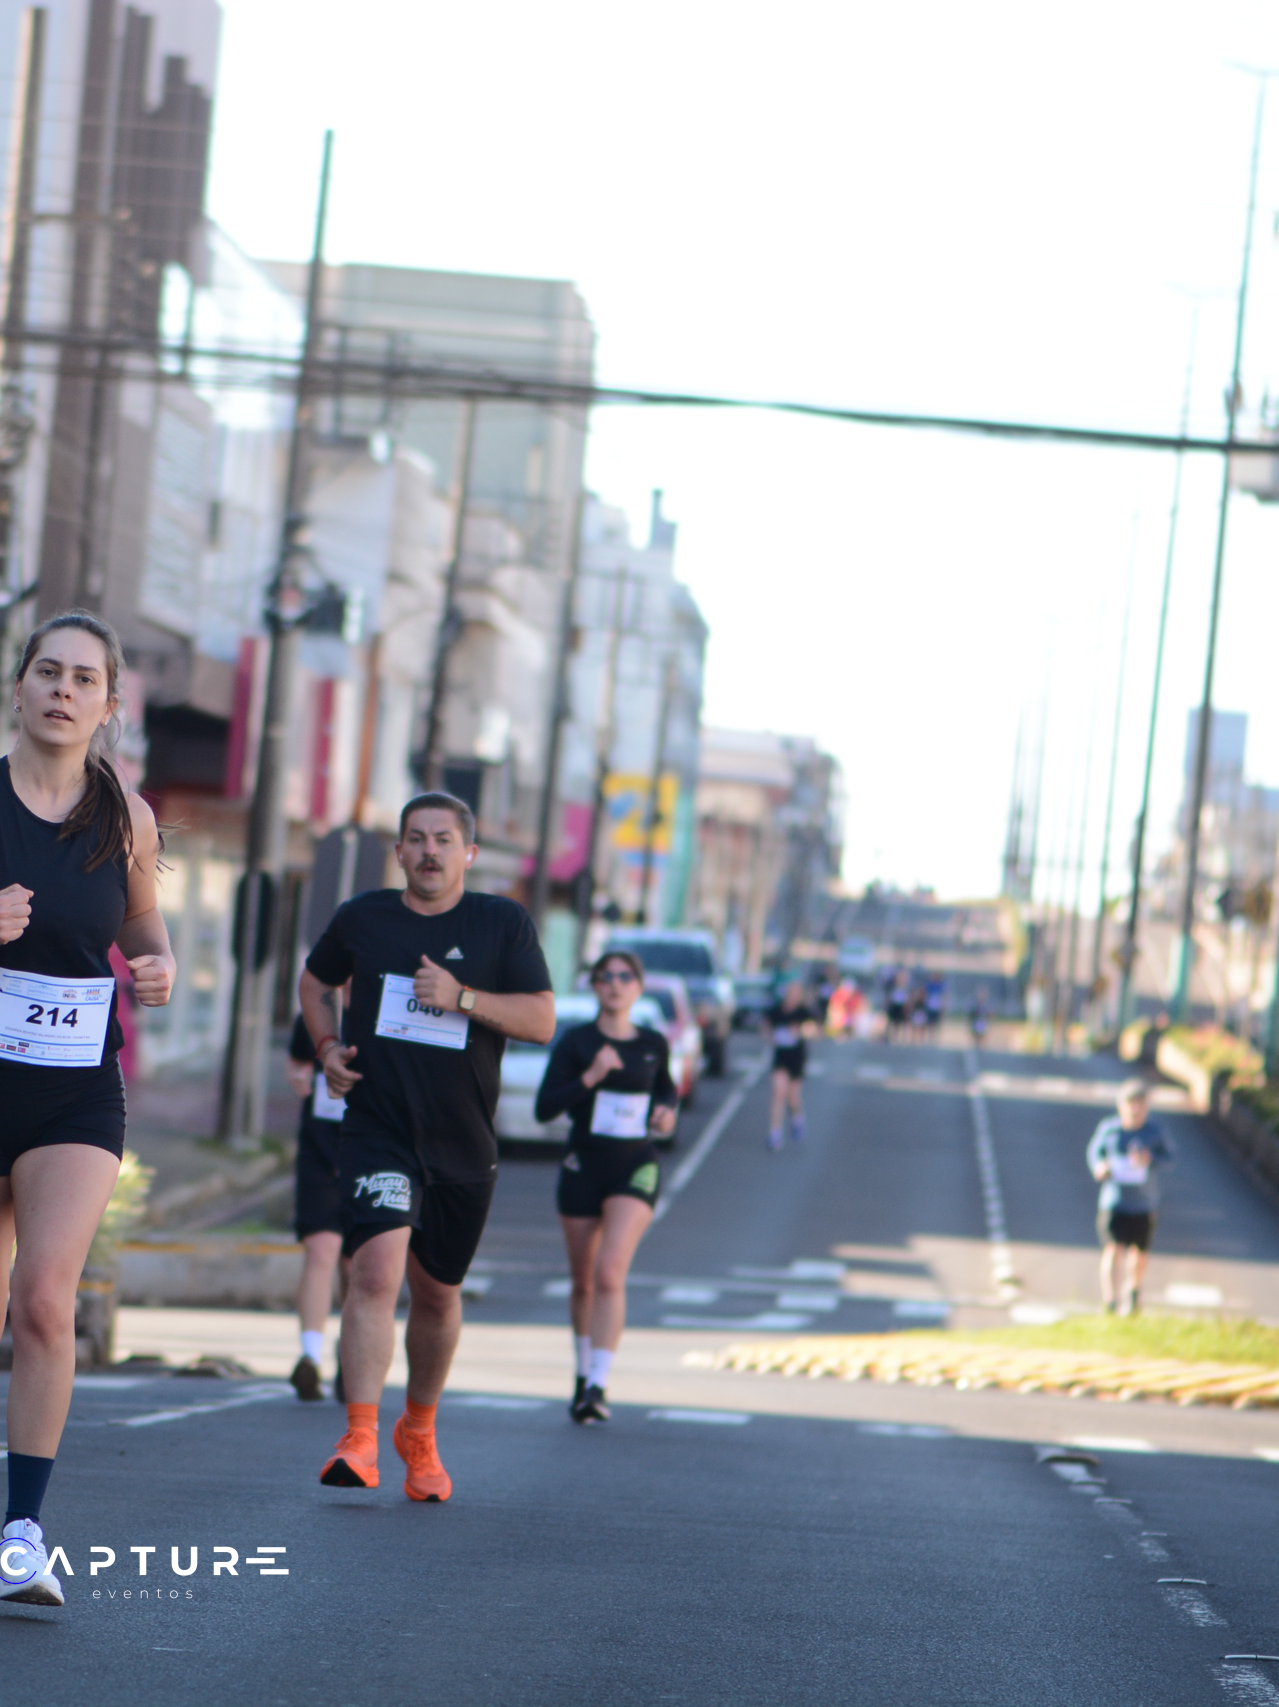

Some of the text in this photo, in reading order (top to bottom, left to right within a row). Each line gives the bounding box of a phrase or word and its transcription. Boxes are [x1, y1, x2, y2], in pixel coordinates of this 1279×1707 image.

[25, 1003, 79, 1028] 214
[354, 1172, 410, 1198] Muay
[369, 1187, 412, 1211] Thai
